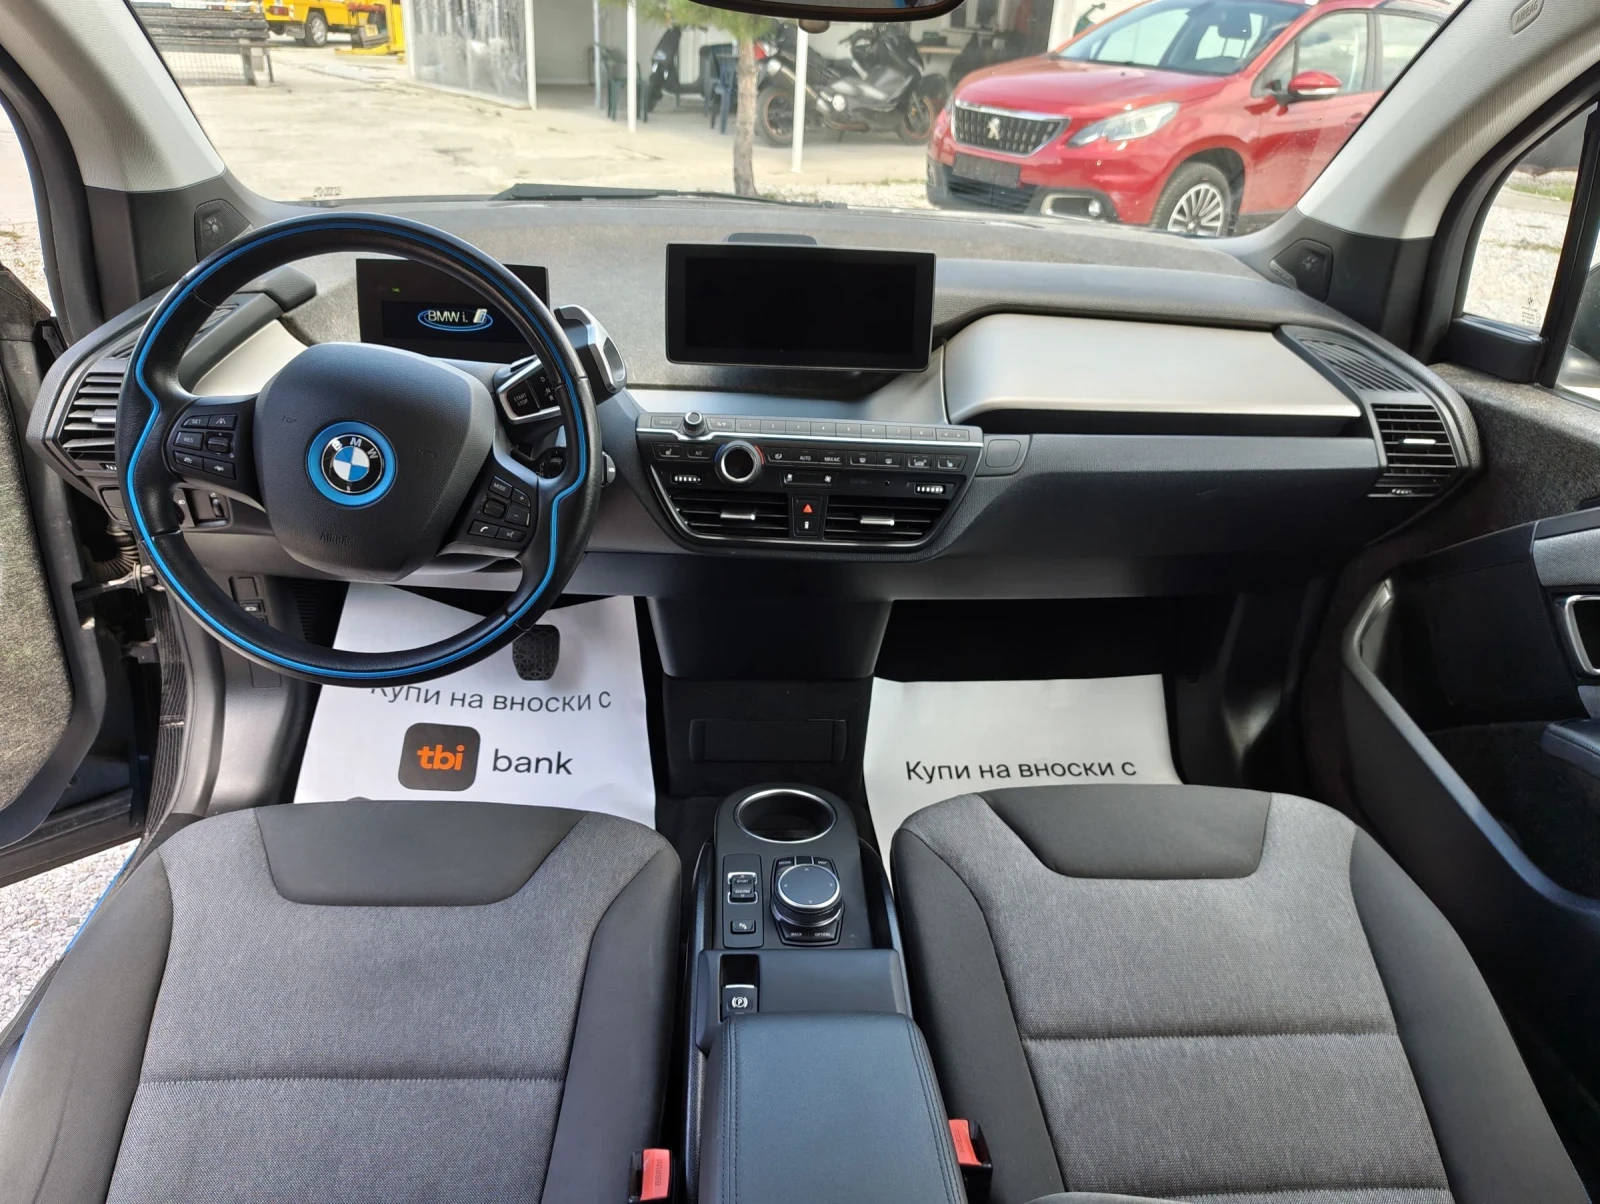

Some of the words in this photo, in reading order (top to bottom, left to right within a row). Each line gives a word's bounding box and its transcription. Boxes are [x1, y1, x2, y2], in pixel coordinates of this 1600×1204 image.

[1515, 0, 1539, 26] AIRBAG
[427, 309, 461, 323] BMW
[513, 392, 527, 402] START
[517, 398, 529, 407] STOP
[799, 454, 812, 462] AUTO
[493, 482, 507, 492] MODE
[449, 691, 484, 709] на
[492, 692, 593, 712] вноски
[598, 690, 612, 709] с
[416, 744, 465, 771] tbi
[492, 749, 574, 776] bank
[905, 760, 971, 785] Купи
[978, 763, 1011, 779] на
[1018, 760, 1115, 778] вноски
[1120, 759, 1138, 777] с
